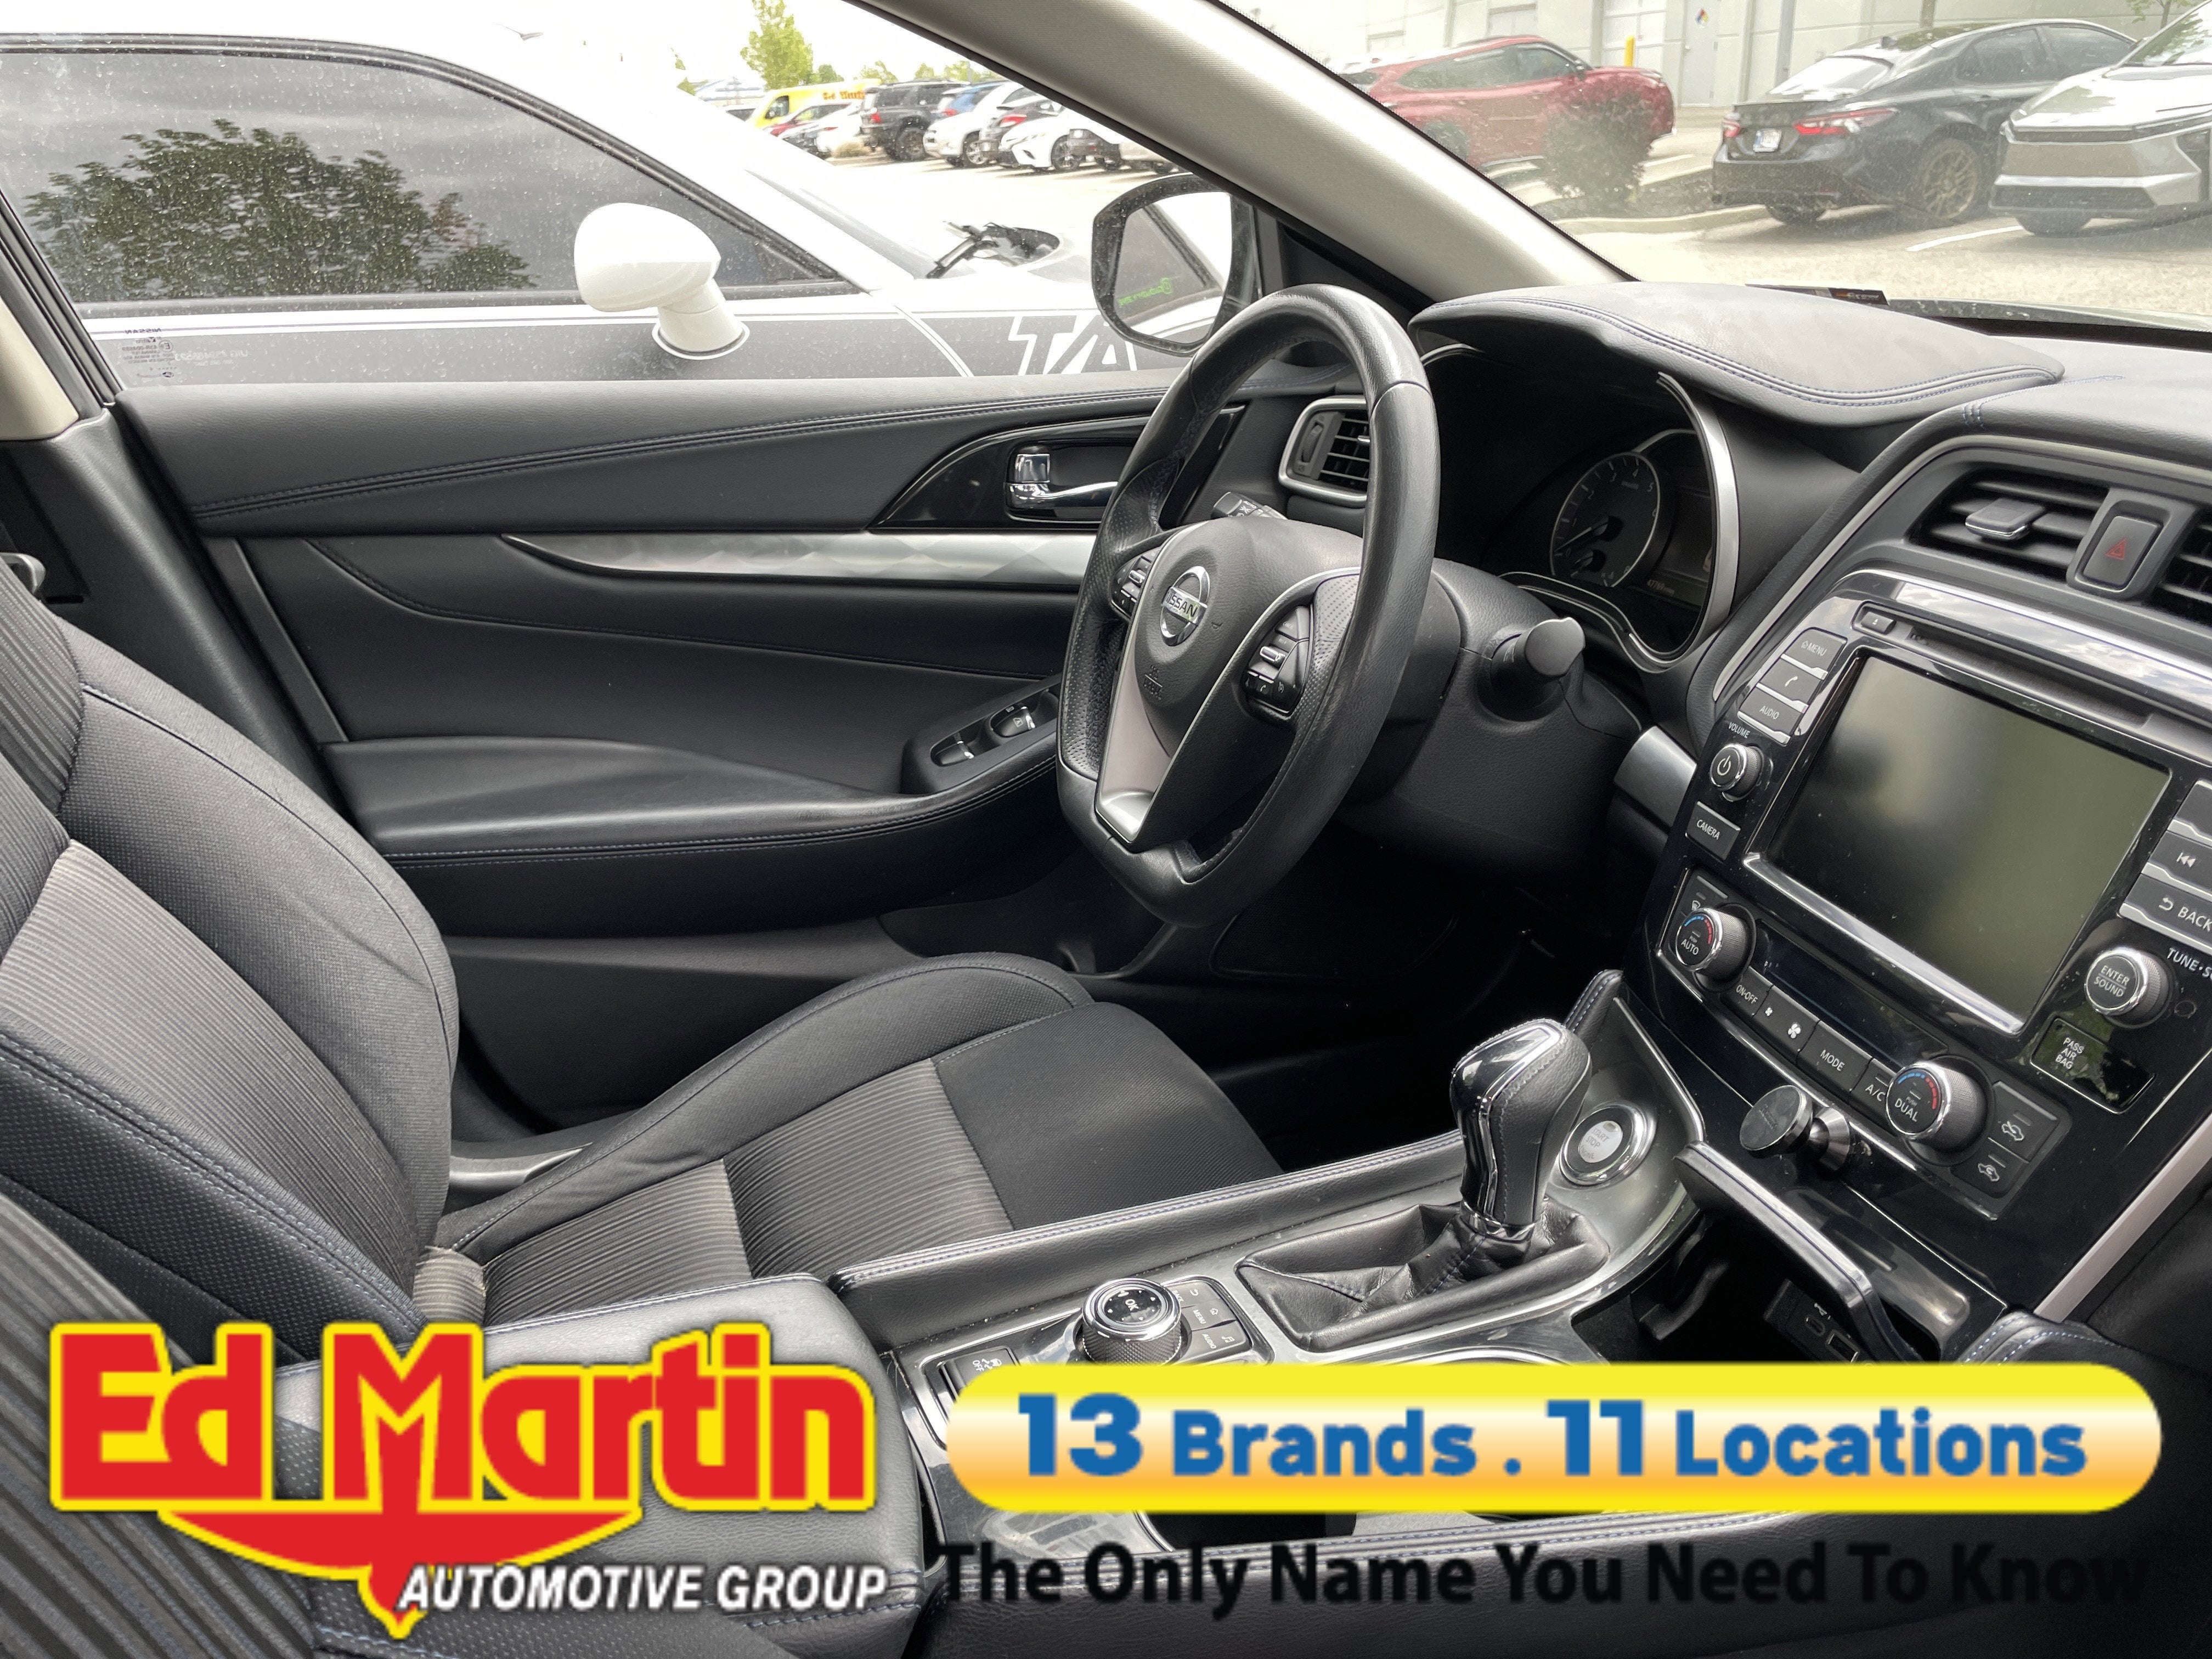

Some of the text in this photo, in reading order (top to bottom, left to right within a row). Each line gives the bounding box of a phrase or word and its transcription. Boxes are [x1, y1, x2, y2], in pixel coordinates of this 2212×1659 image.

[1807, 642, 1827, 657] MENU
[1759, 706, 1780, 720] AUDIO
[1728, 722, 1751, 739] VOLUME
[1696, 819, 1720, 840] CAMERA
[2177, 906, 2212, 932] BACK
[1680, 939, 1699, 955] AUTO
[2101, 964, 2130, 986] ENTER
[2094, 977, 2125, 998] SOUND
[2063, 1037, 2084, 1054] PASS
[1820, 1049, 1845, 1071] MODE
[2055, 1054, 2073, 1069] BAG
[2061, 1047, 2076, 1061] AIR
[1865, 1084, 1886, 1102] A/C
[1894, 1098, 1918, 1122] DUAL
[1586, 1136, 1601, 1148] STOP
[1592, 1128, 1609, 1142] START
[1125, 1299, 1139, 1311] OK
[1193, 1309, 1206, 1324] MENU
[1202, 1334, 1216, 1349] AUDIO
[973, 1360, 984, 1372] OFF
